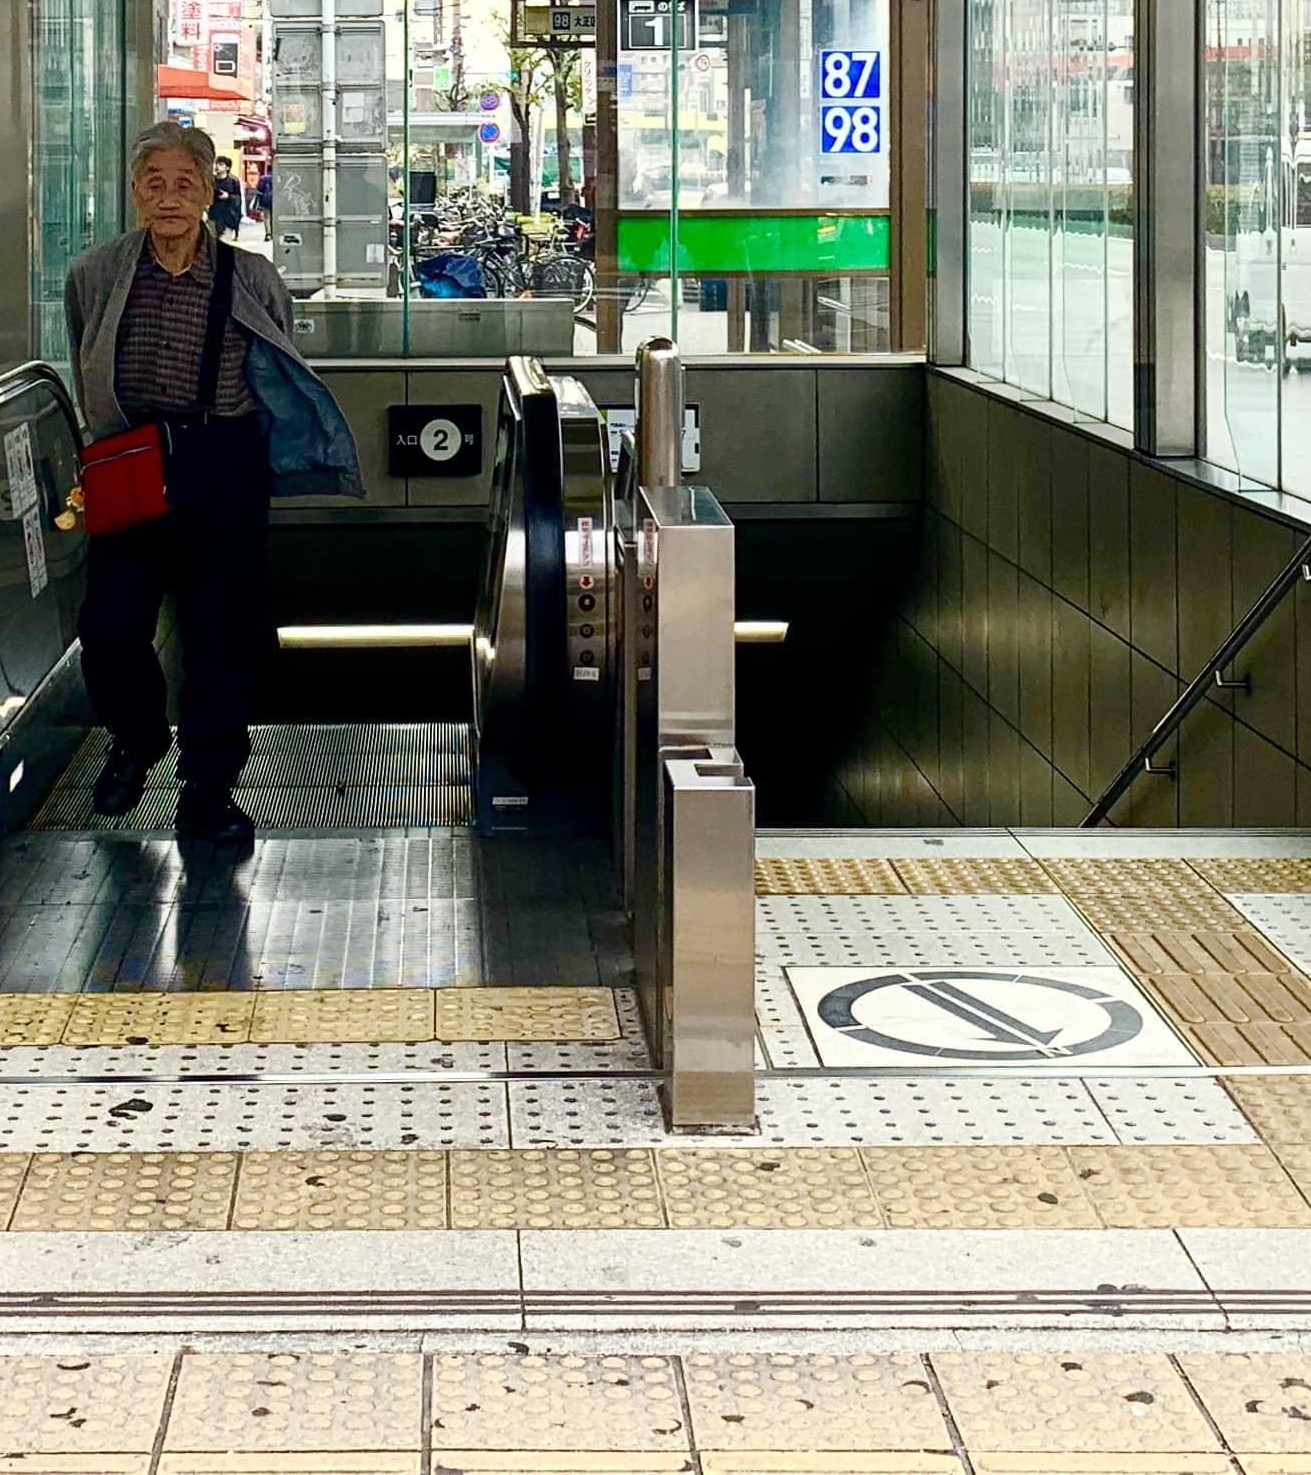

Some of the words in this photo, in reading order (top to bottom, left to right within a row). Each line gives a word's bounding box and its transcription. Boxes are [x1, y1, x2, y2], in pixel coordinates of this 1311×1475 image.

[553, 11, 570, 29] 98
[644, 16, 665, 46] 1
[823, 51, 878, 98] 87
[824, 106, 879, 153] 98
[395, 434, 418, 446] 入口
[433, 428, 449, 451] 2
